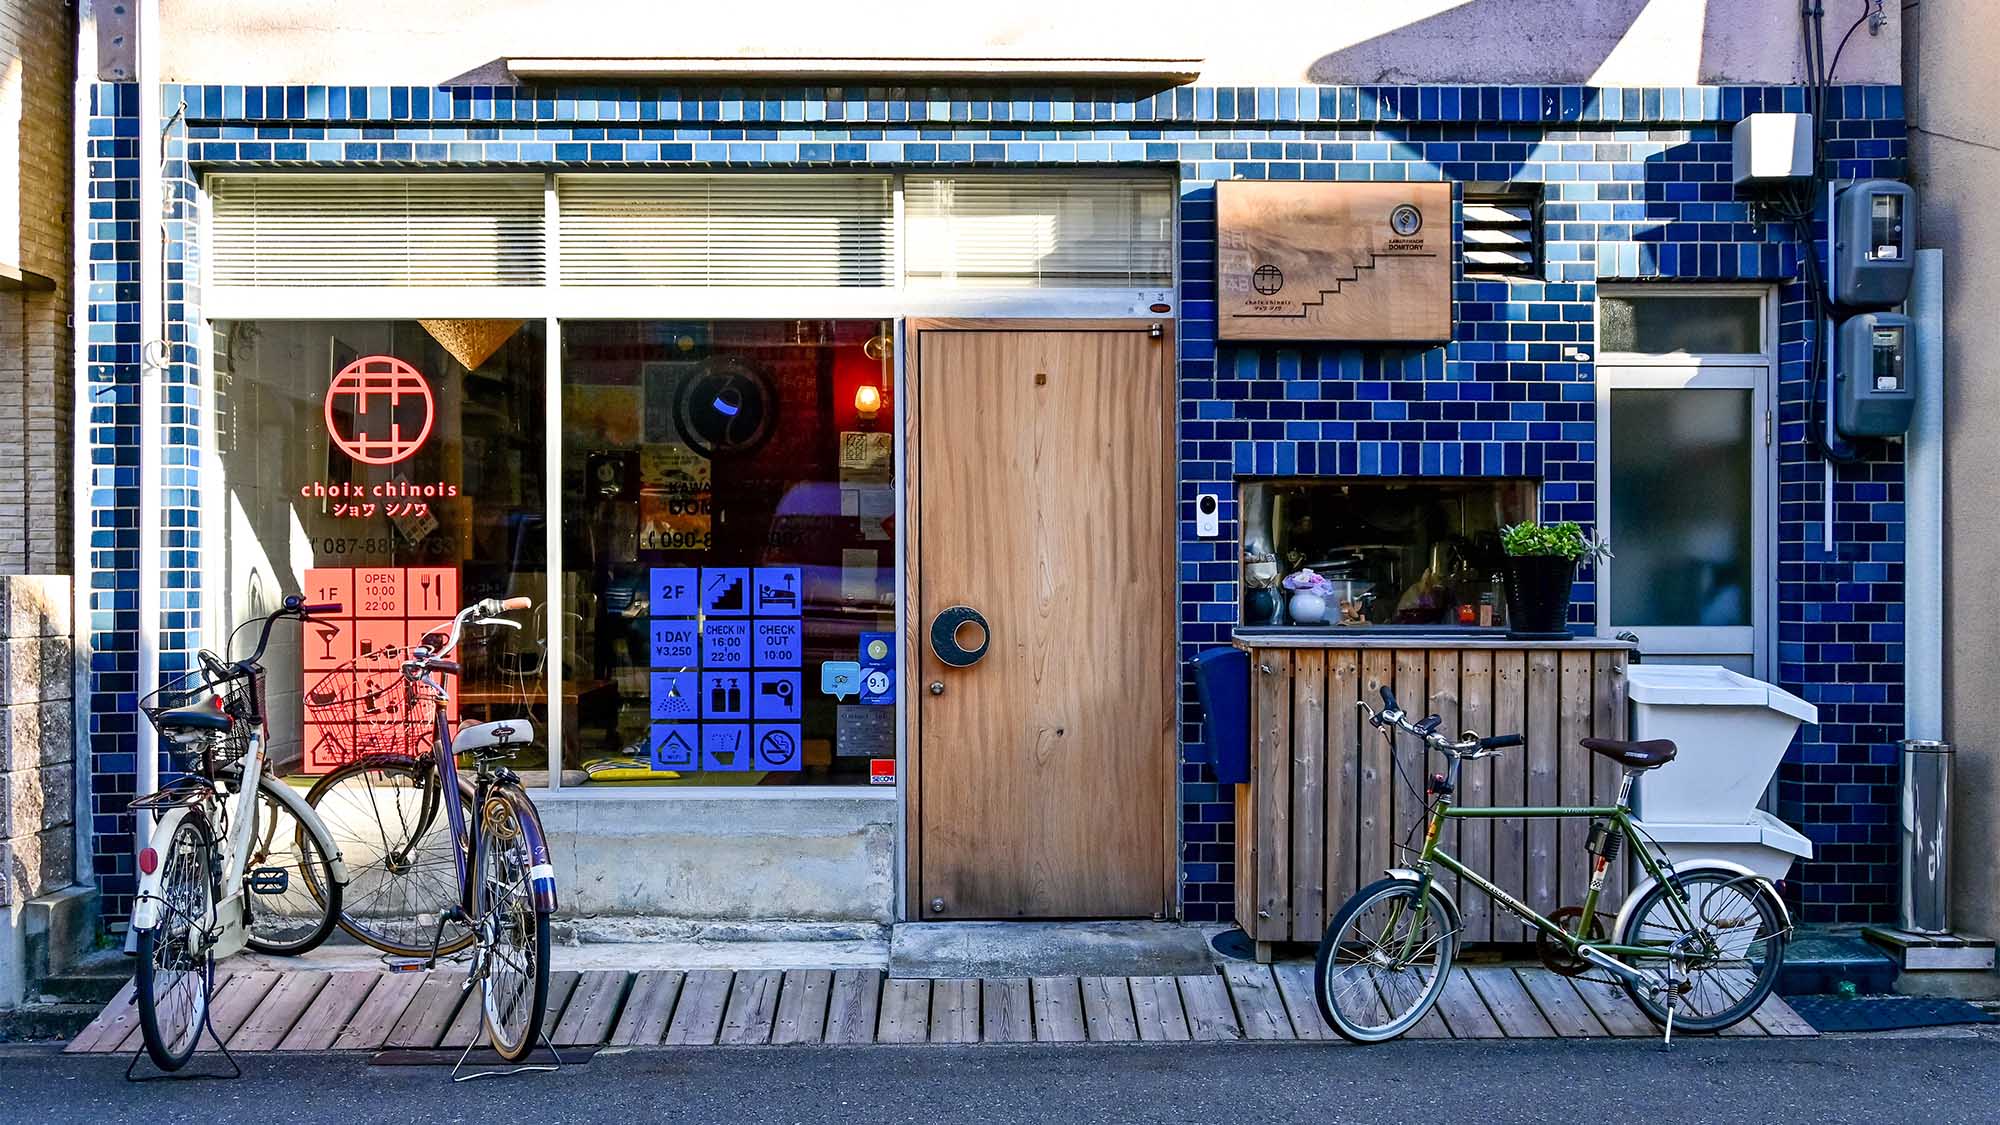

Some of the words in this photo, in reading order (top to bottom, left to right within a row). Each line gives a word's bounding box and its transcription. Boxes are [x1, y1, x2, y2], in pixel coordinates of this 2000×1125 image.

[301, 481, 364, 497] choix
[373, 481, 457, 497] chinois
[333, 503, 376, 517] ショワ
[385, 503, 428, 517] シノワ
[364, 574, 395, 583] OPEN
[319, 587, 338, 600] 1F
[366, 586, 395, 596] 10:00
[662, 585, 685, 599] 2F
[365, 601, 395, 611] 22:00
[706, 625, 735, 635] CHECK
[736, 625, 745, 635] IN
[759, 625, 796, 635] CHECK
[656, 631, 661, 642] 1
[665, 631, 692, 642] DAY
[766, 636, 789, 646] OUT
[712, 637, 741, 647] 16:00
[711, 652, 741, 662] 22:00
[764, 650, 792, 660] 10:00
[869, 677, 886, 688] 9.1
